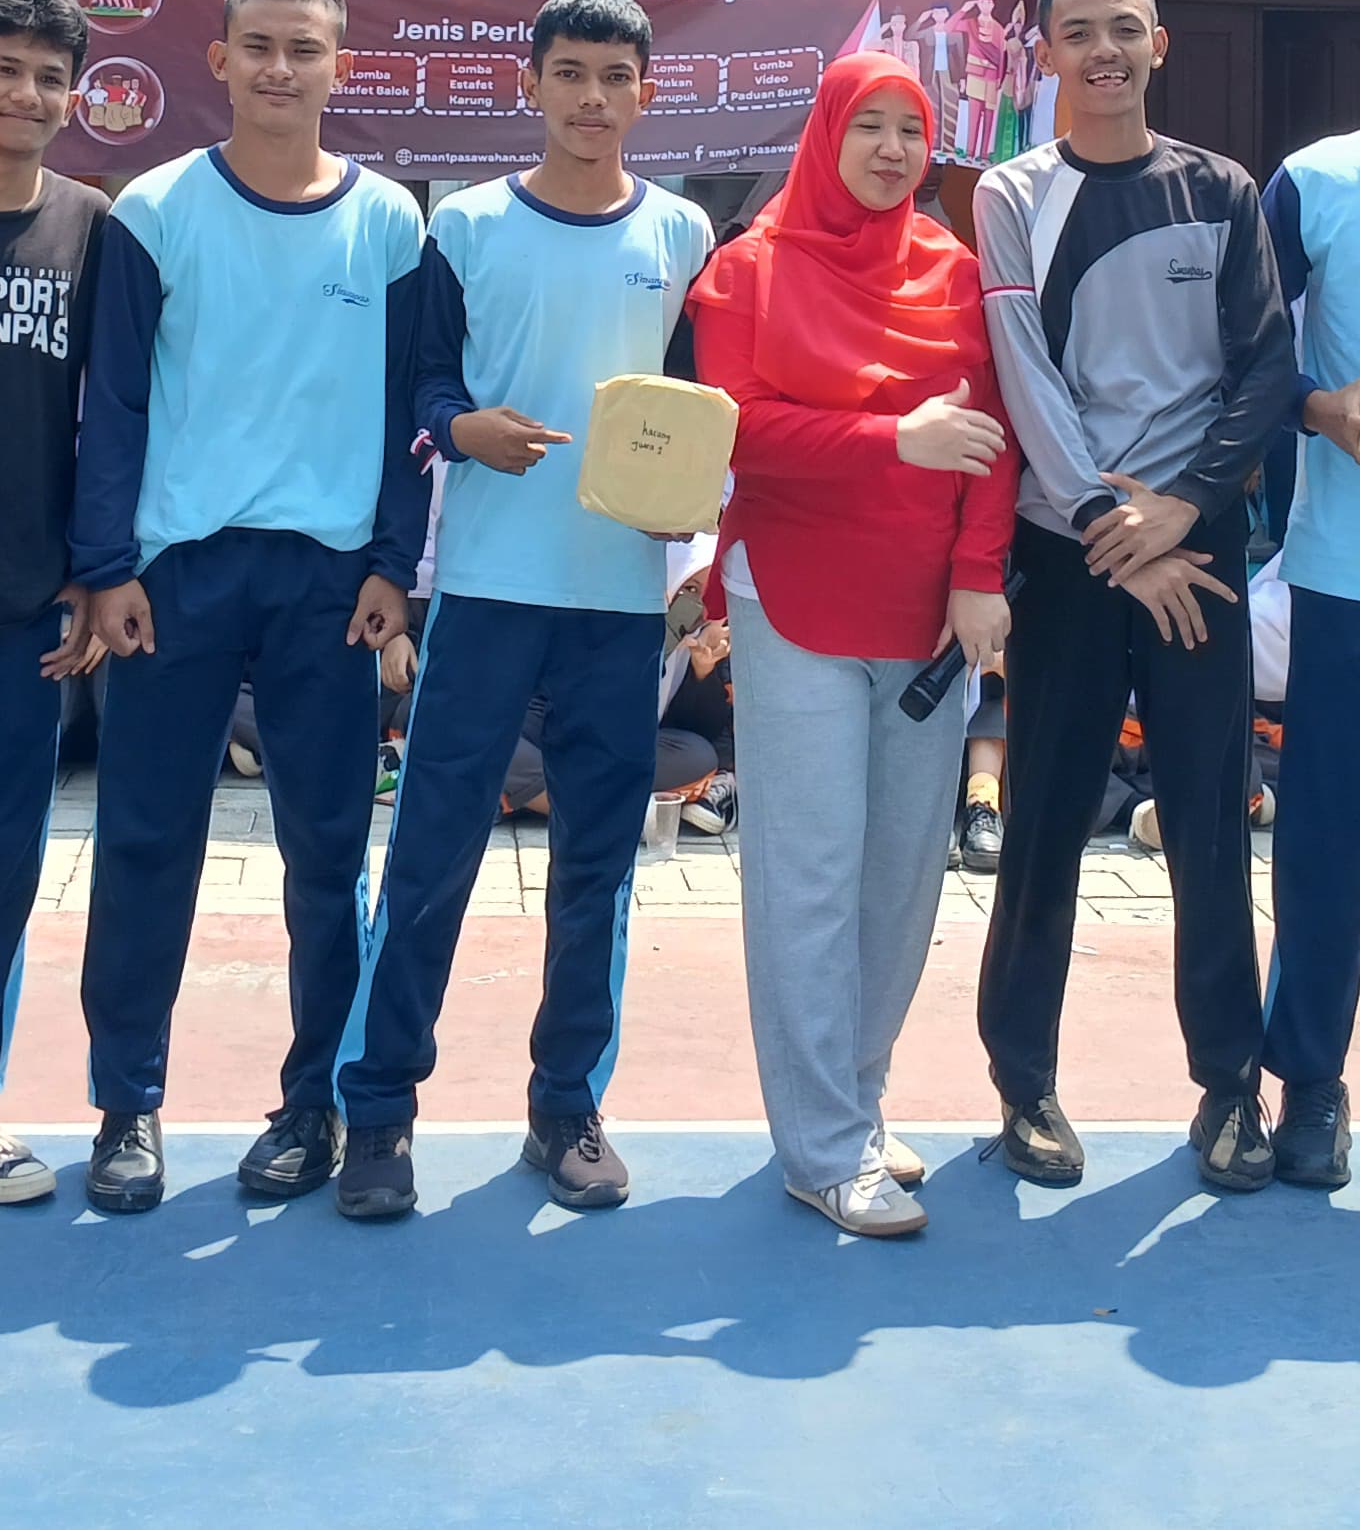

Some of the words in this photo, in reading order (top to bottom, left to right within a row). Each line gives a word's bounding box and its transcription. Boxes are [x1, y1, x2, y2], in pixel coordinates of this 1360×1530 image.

[393, 19, 464, 43] Jenis
[471, 21, 534, 43] Perl
[451, 64, 492, 74] Lomba
[653, 64, 693, 73] Lomba
[753, 59, 793, 71] Lomba
[350, 70, 390, 80] Lomba
[755, 75, 788, 85] Video
[450, 80, 493, 90] Estafet
[655, 78, 692, 87] Makan
[377, 86, 409, 96] Balok
[731, 90, 774, 101] Paduan
[777, 87, 810, 98] Suara
[449, 96, 493, 107] Karung
[6, 266, 31, 278] OUR
